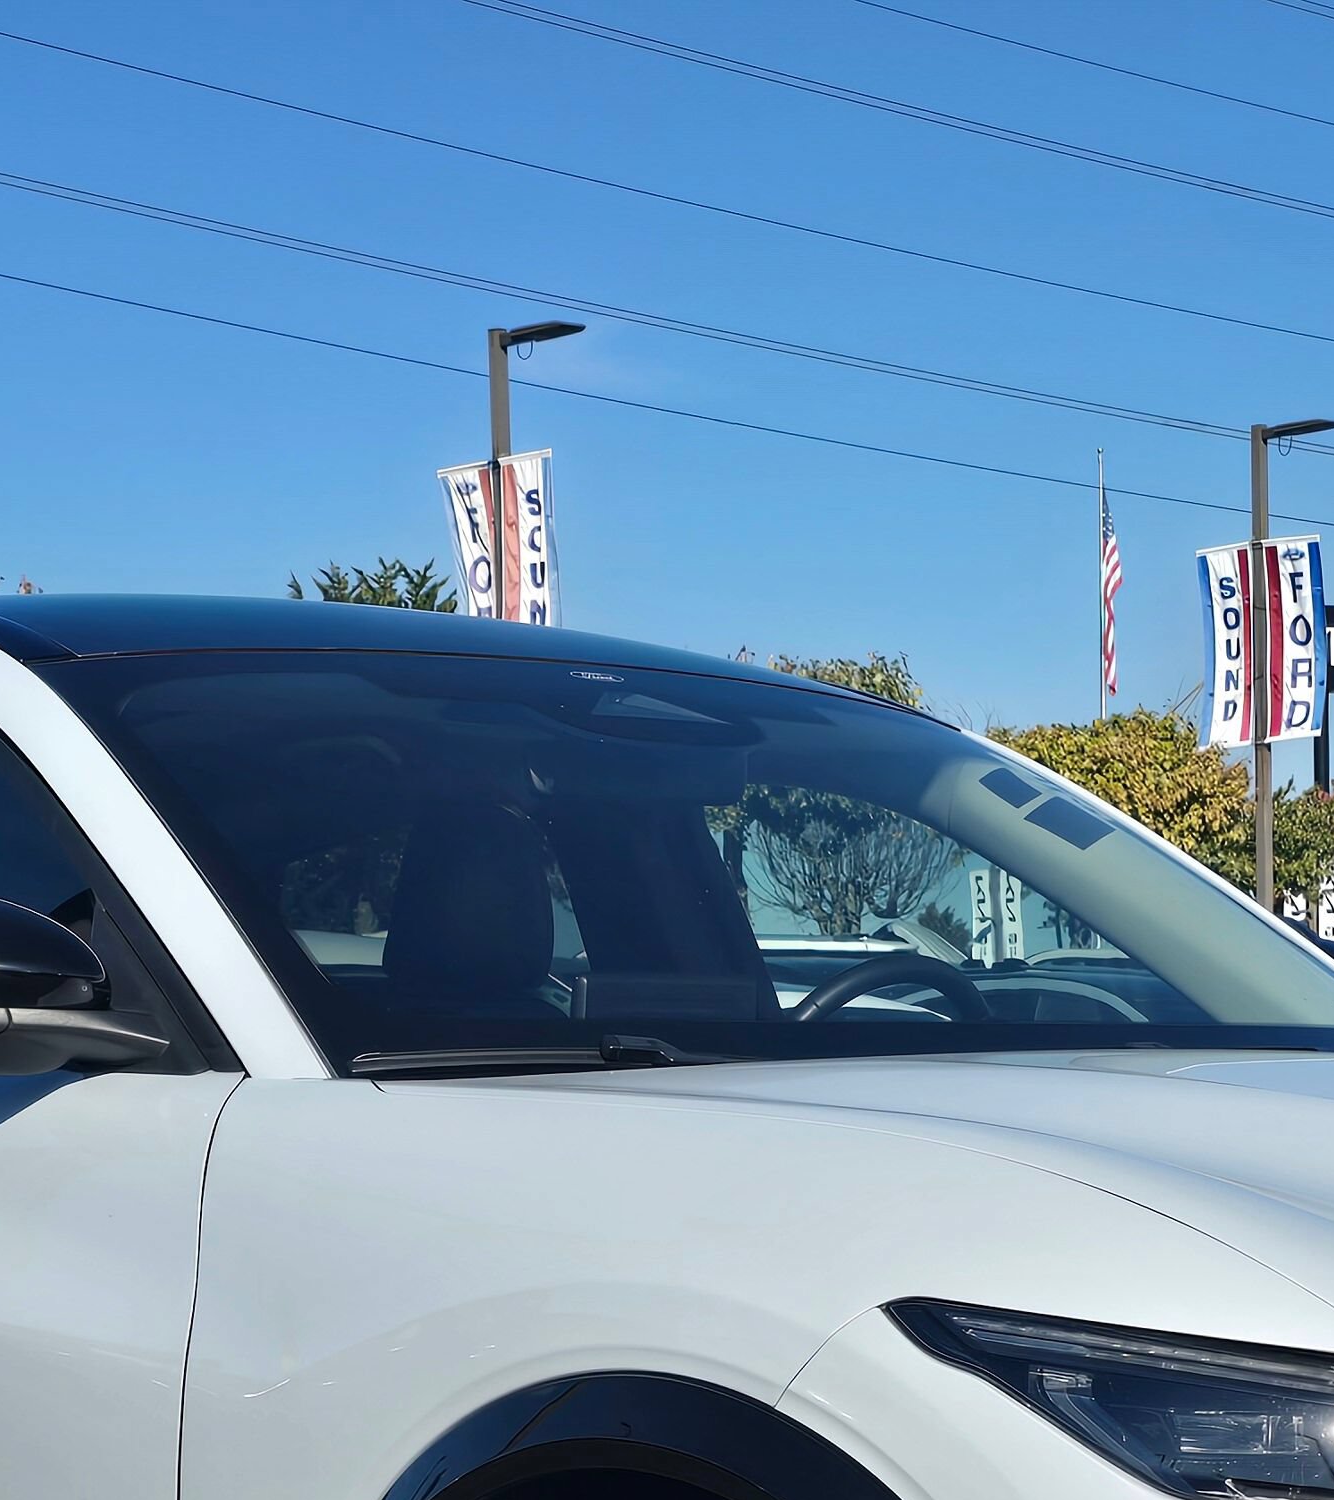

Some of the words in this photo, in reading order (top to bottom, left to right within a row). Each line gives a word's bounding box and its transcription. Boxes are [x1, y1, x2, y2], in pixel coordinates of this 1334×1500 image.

[525, 488, 547, 627] SOUN
[1219, 576, 1241, 722] SOUND
[1285, 572, 1313, 729] FORD
